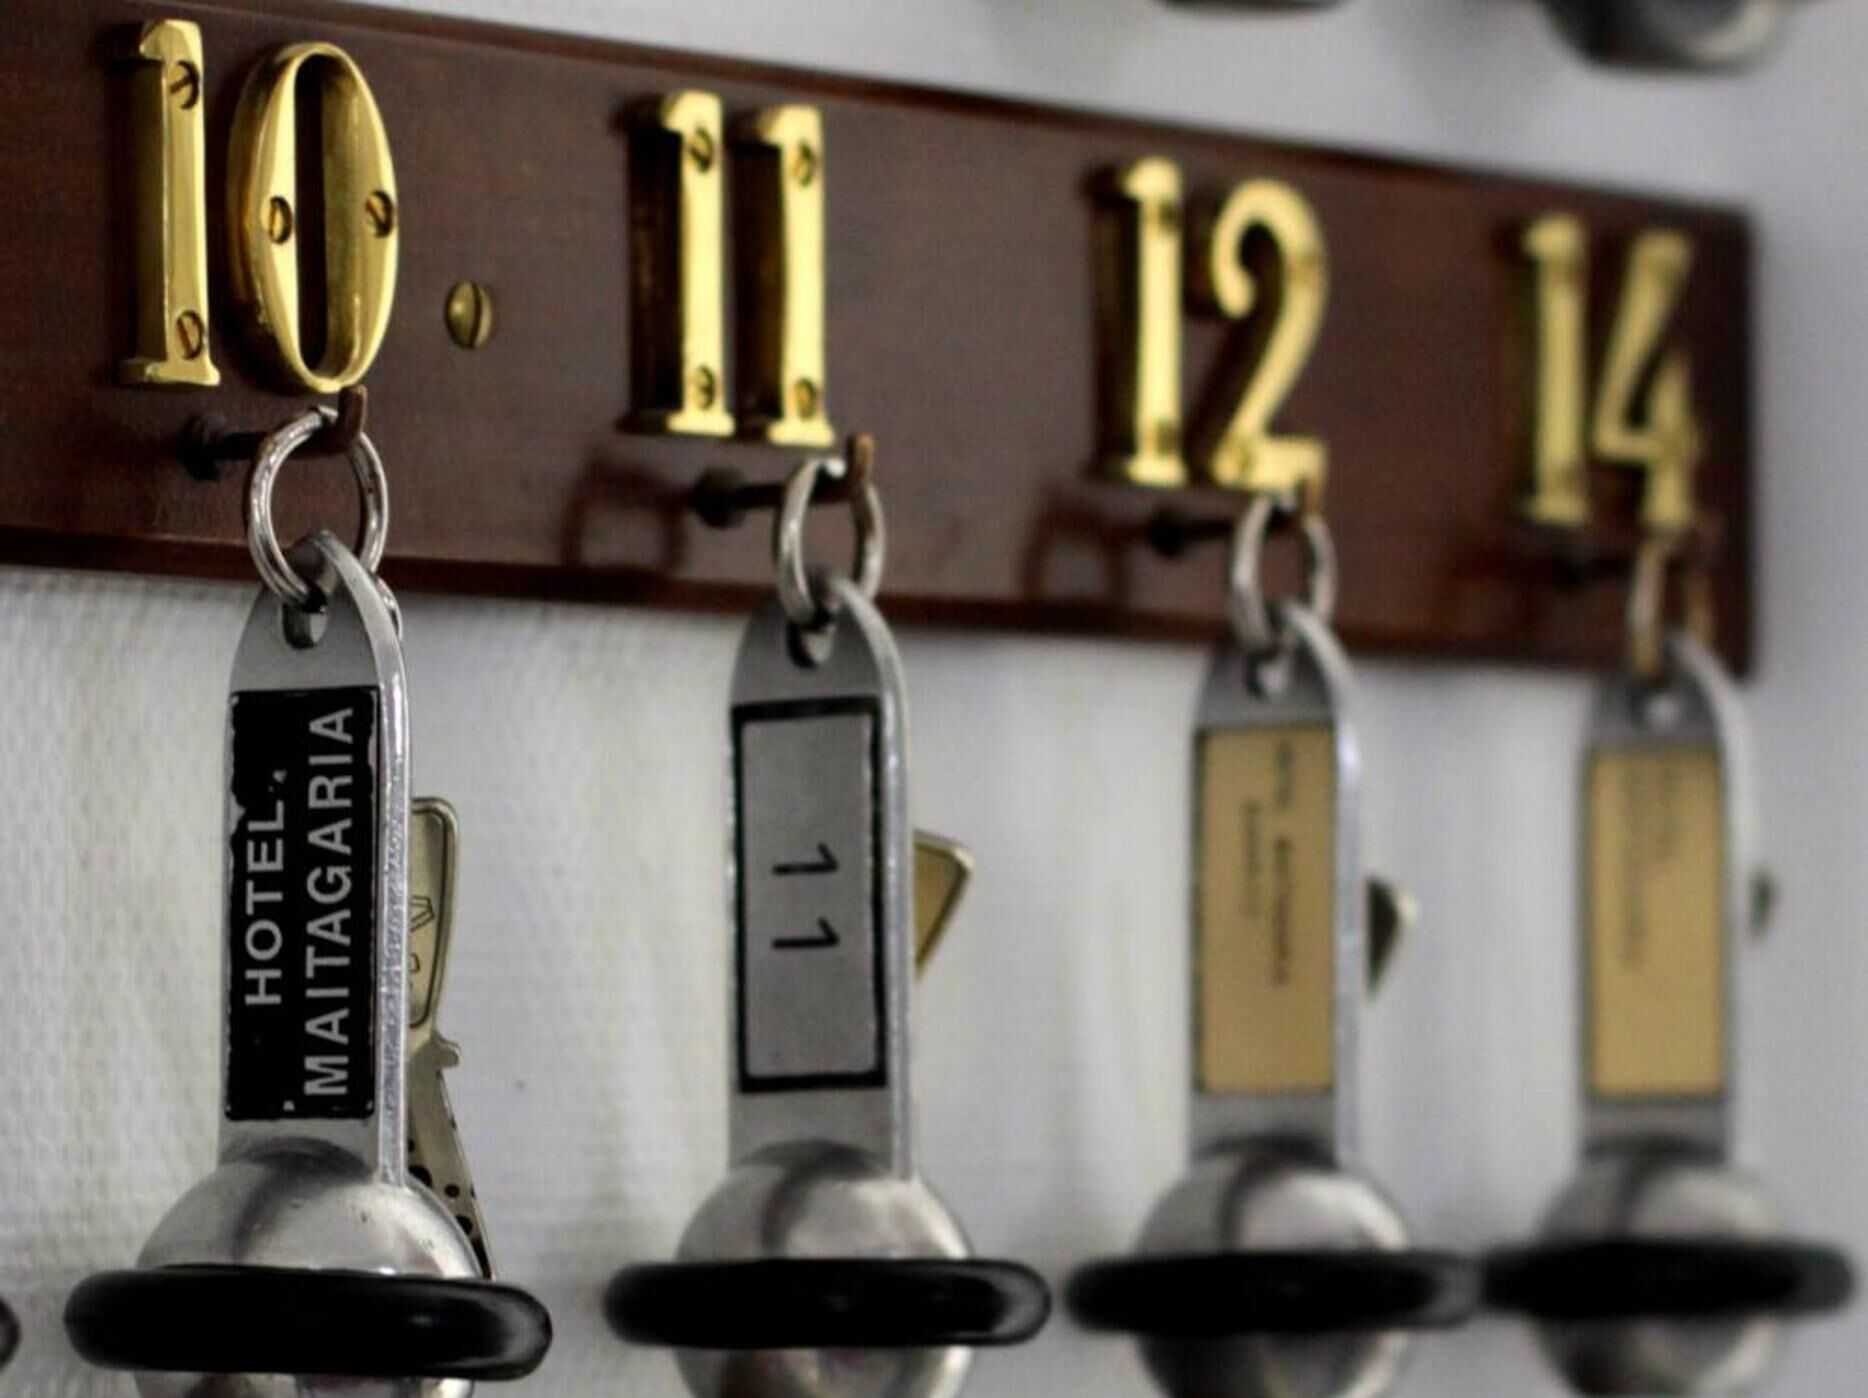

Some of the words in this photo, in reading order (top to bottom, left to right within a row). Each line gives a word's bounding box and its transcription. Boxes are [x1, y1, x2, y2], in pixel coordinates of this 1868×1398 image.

[121, 19, 399, 392] 10
[645, 90, 833, 445] 11
[1122, 157, 1328, 488] 12
[1523, 213, 1700, 540] 14
[244, 800, 286, 1005] HOTEL
[303, 708, 353, 1096] MAITAGARIA
[771, 842, 840, 949] 11
